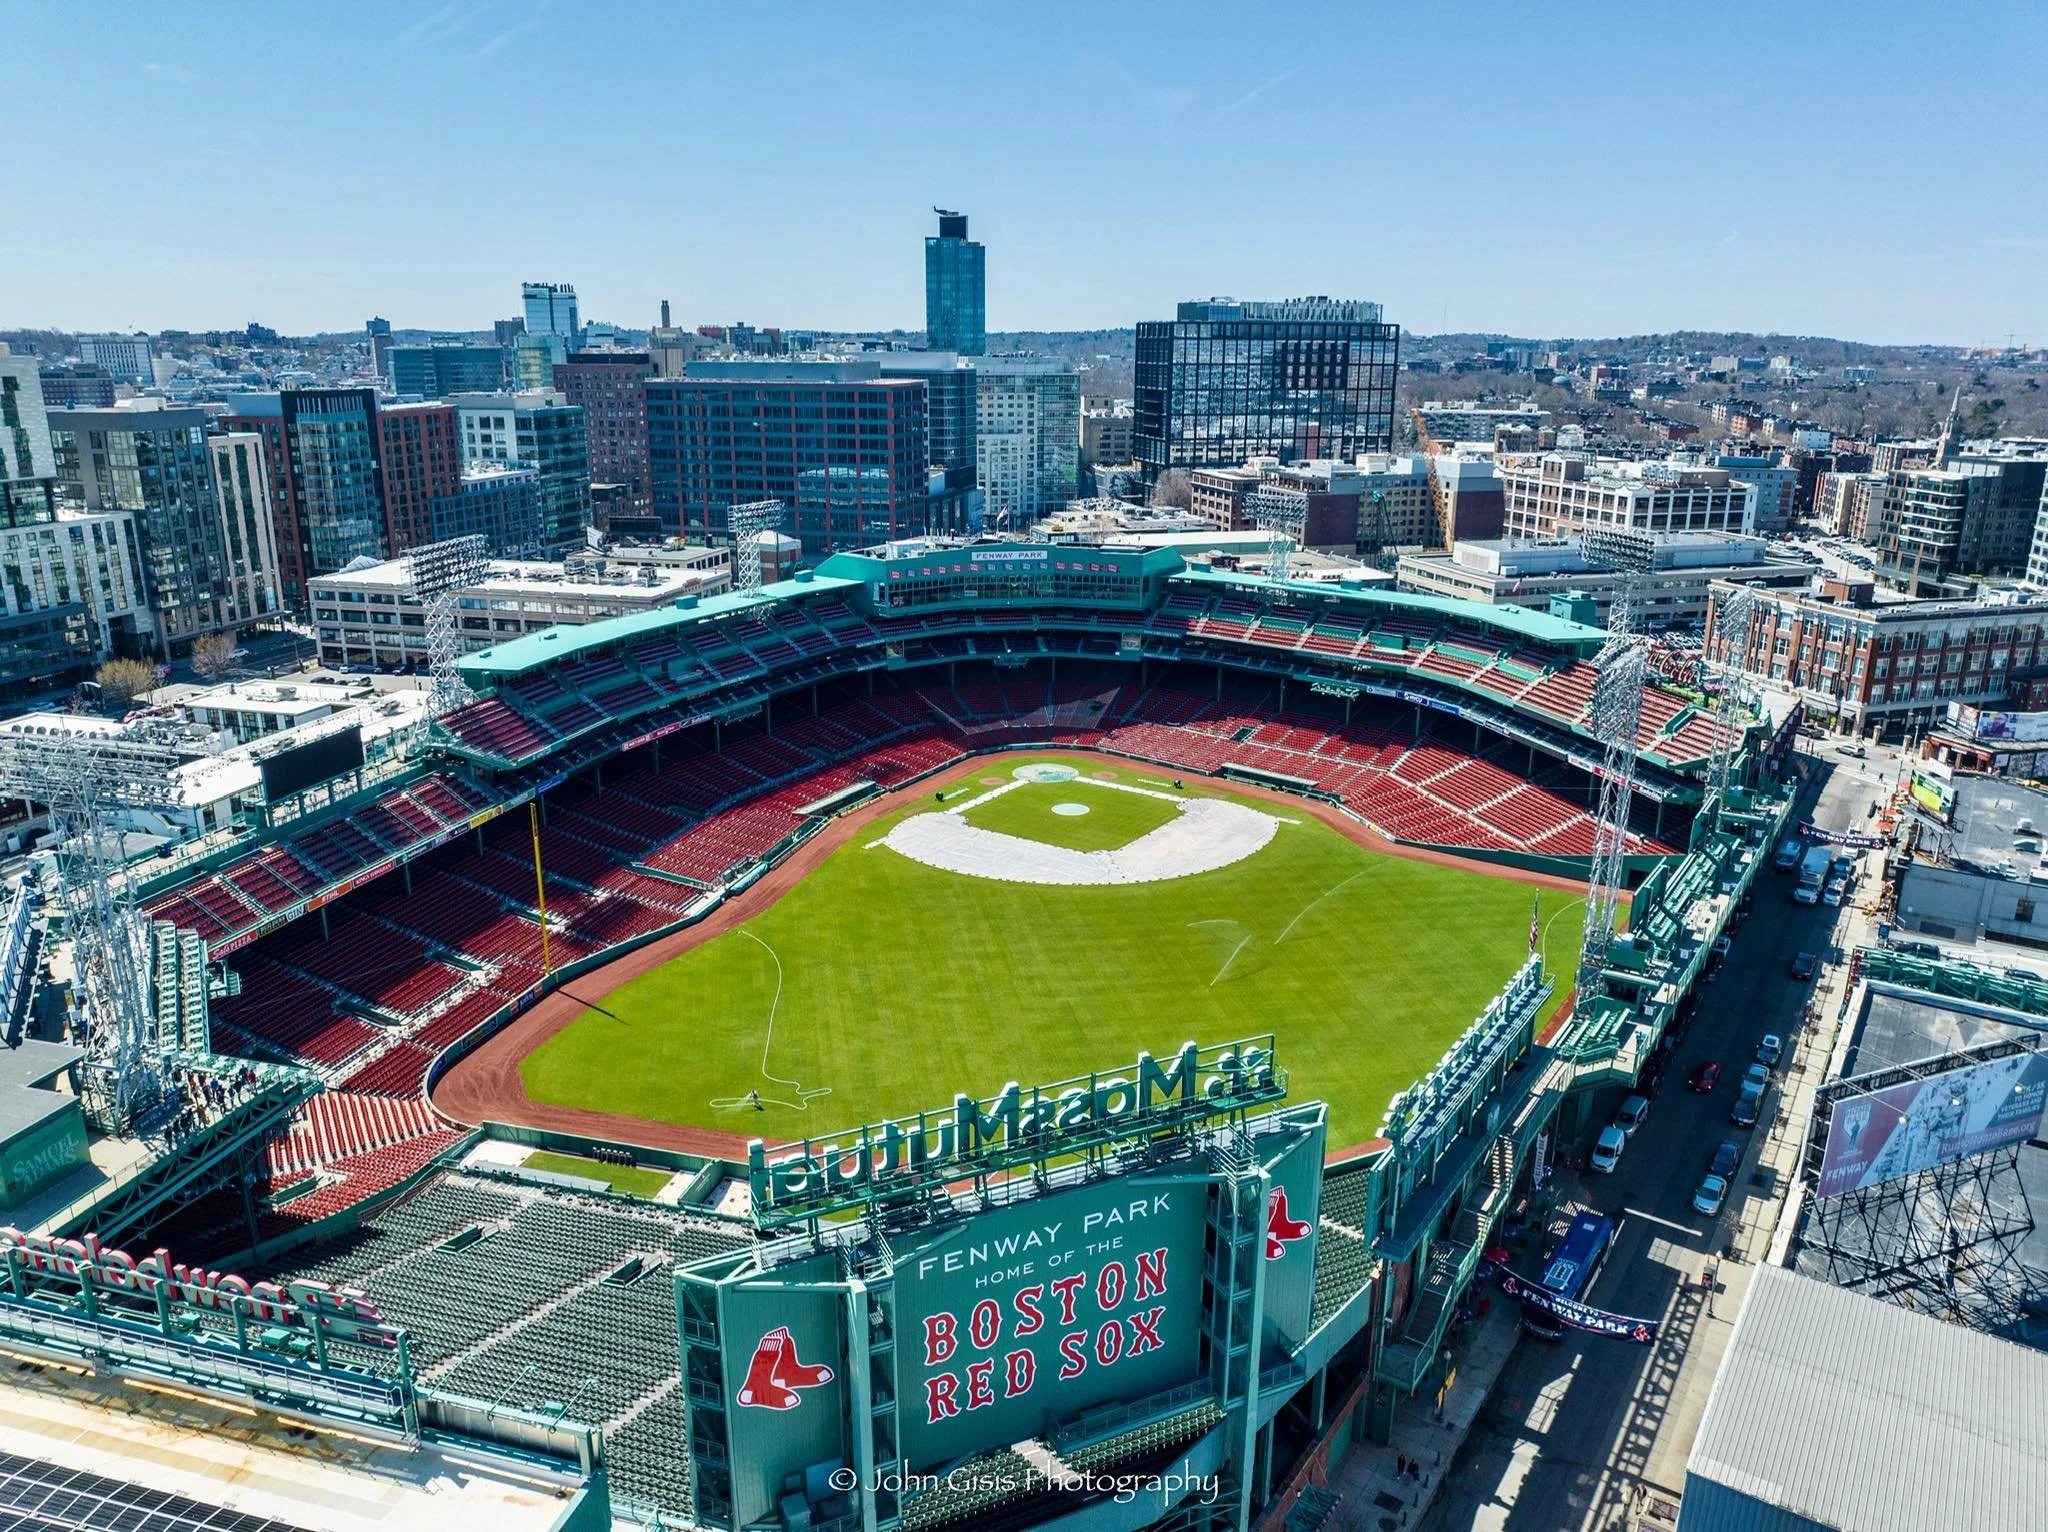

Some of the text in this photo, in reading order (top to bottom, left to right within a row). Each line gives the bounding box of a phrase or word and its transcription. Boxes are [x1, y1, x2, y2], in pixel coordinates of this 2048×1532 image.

[976, 551, 1042, 560] FENWAY PARK
[287, 905, 305, 920] GIN
[230, 934, 252, 951] PIZZA
[13, 1132, 79, 1181] SAMUEL
[24, 1150, 76, 1192] ADAMS
[1826, 1161, 1868, 1181] FENWAY
[919, 1193, 1171, 1280] FENWAY PARK
[975, 1236, 1124, 1289] HOME OF THE
[922, 1247, 1169, 1366] BOSTON
[1522, 1288, 1629, 1335] FENWAY PARK
[1555, 1297, 1599, 1317] WELCOME TO
[924, 1305, 1166, 1424] RED SOX
